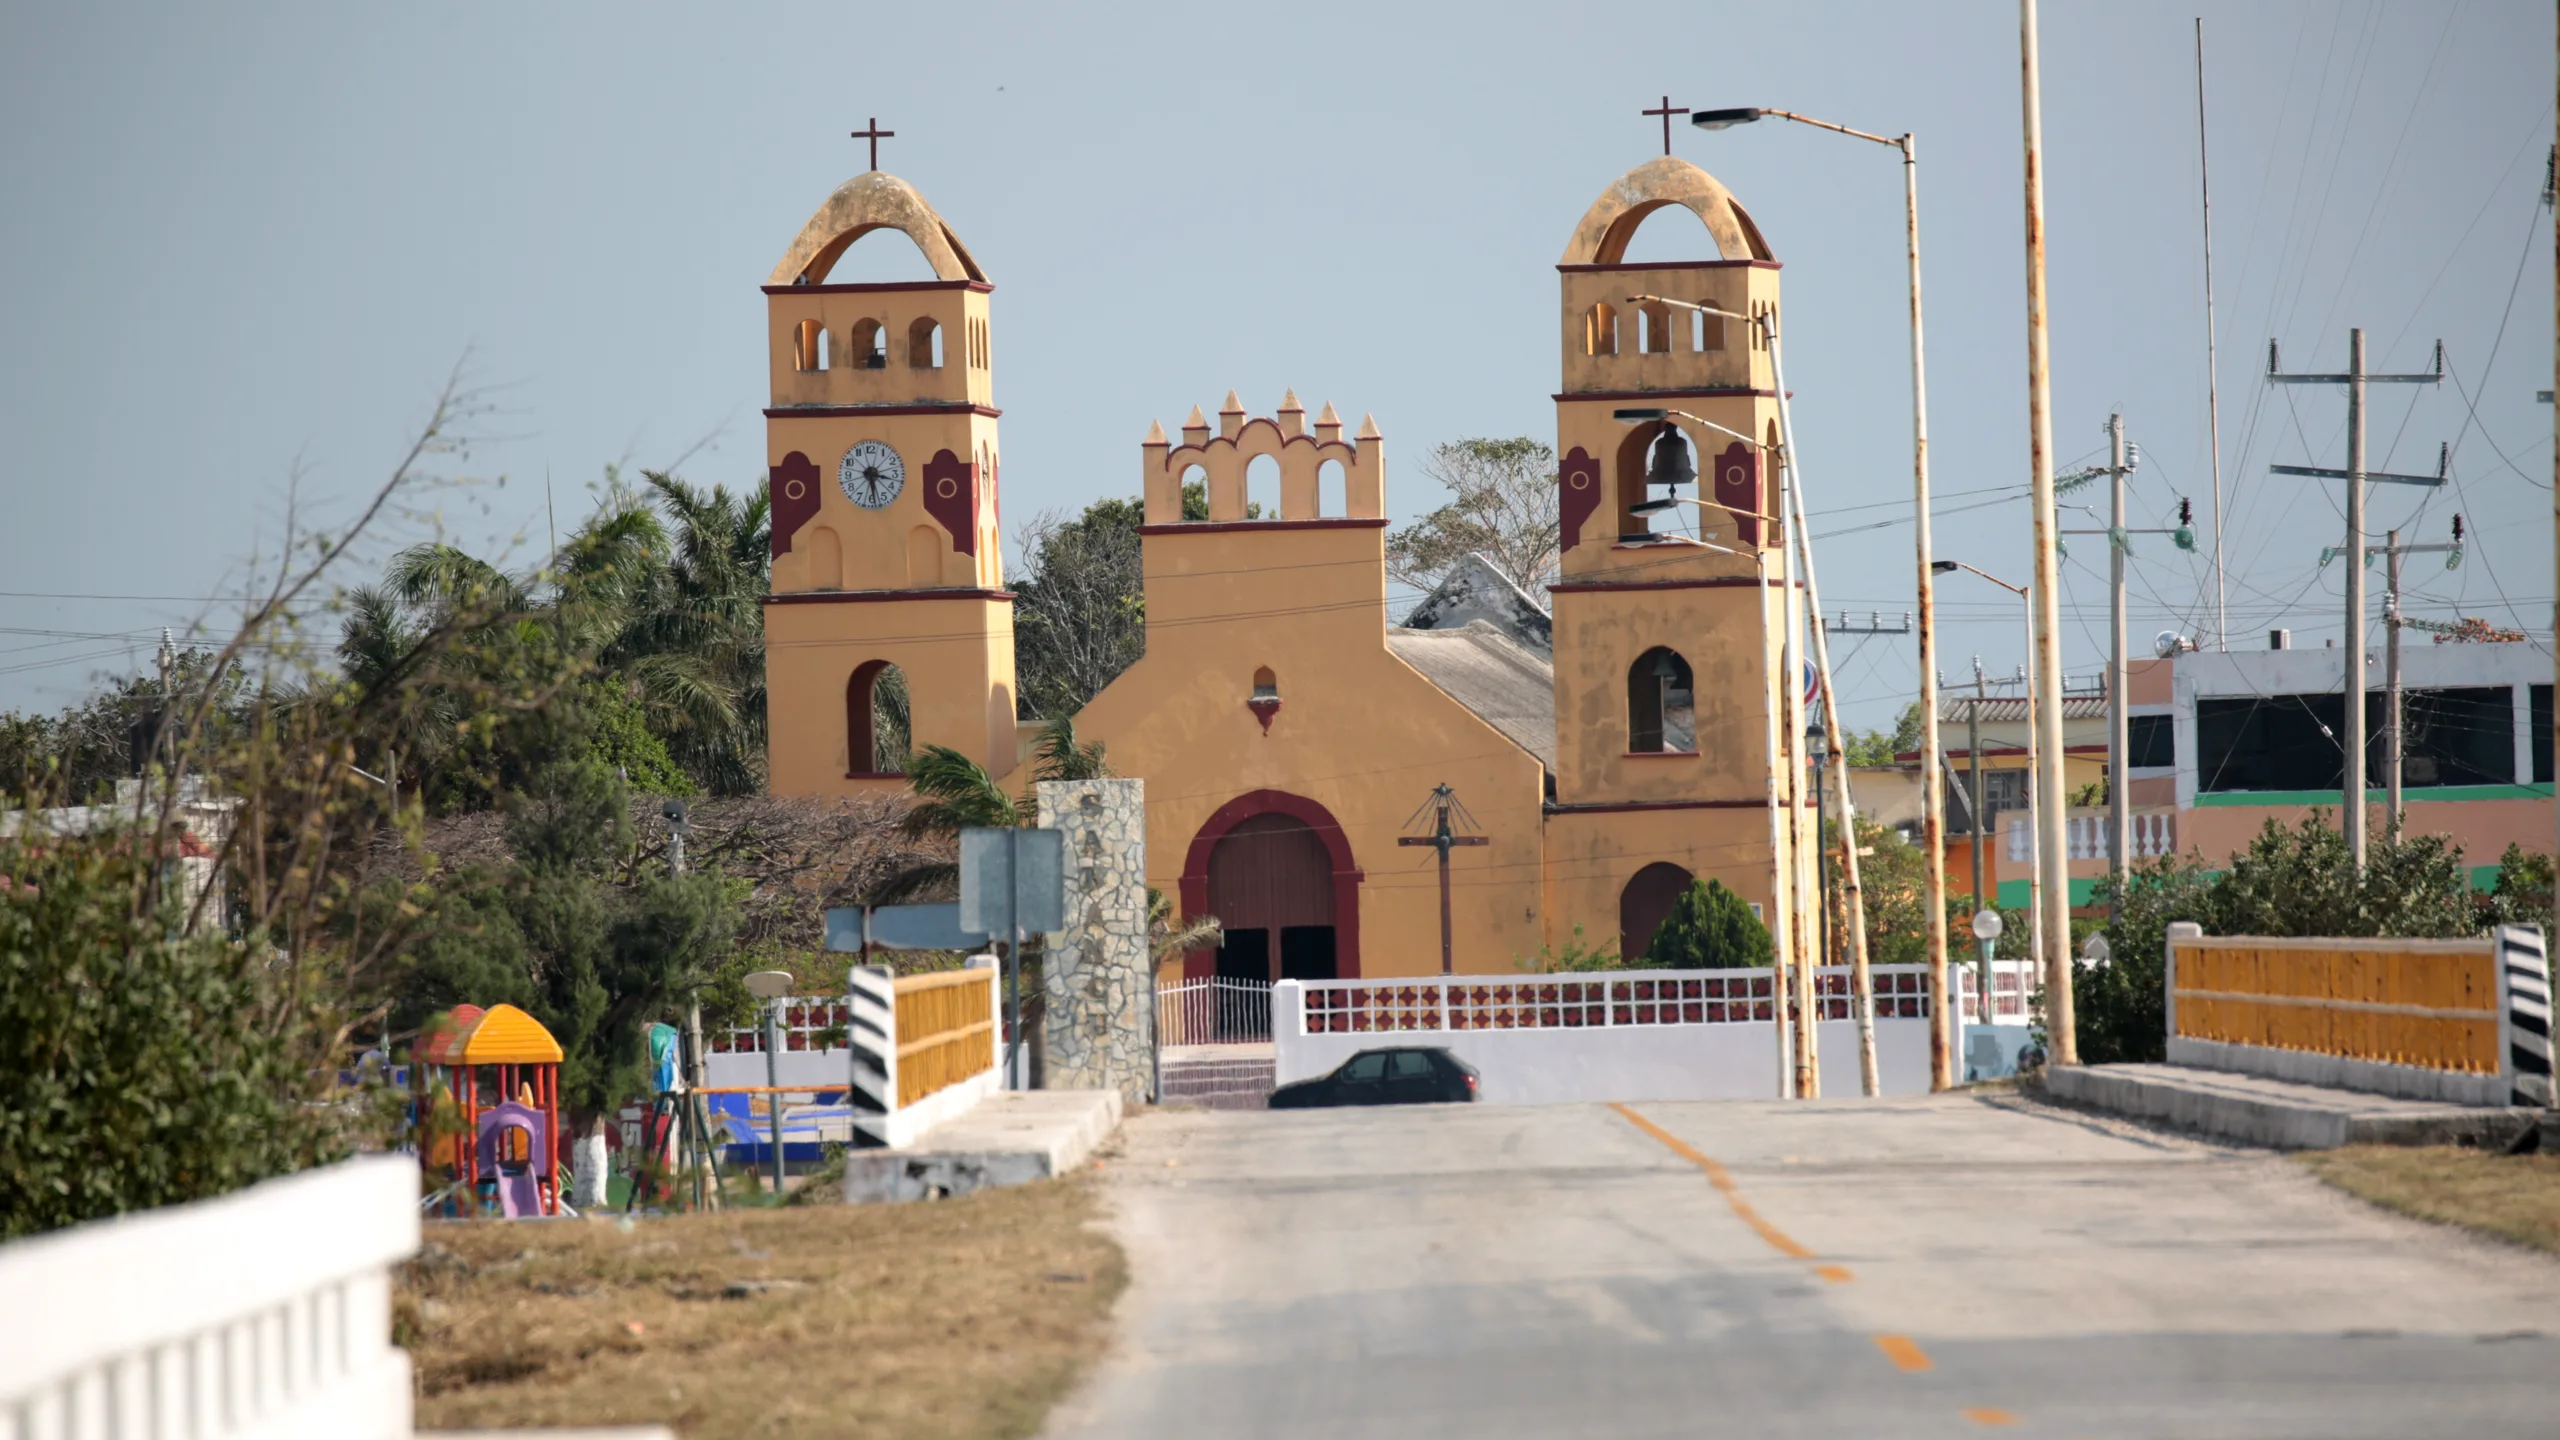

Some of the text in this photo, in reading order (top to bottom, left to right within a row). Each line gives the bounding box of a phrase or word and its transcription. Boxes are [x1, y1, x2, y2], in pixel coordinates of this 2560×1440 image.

[856, 448, 862, 456] 11
[866, 445, 875, 454] 12
[881, 448, 885, 457] 1
[845, 458, 854, 466] 10
[889, 457, 896, 465] 2
[845, 471, 852, 479] 9
[892, 470, 898, 478] 3
[848, 483, 854, 491] 8
[888, 481, 894, 490] 4
[856, 492, 863, 501] 7
[868, 494, 875, 503] 6
[881, 492, 887, 501] 5
